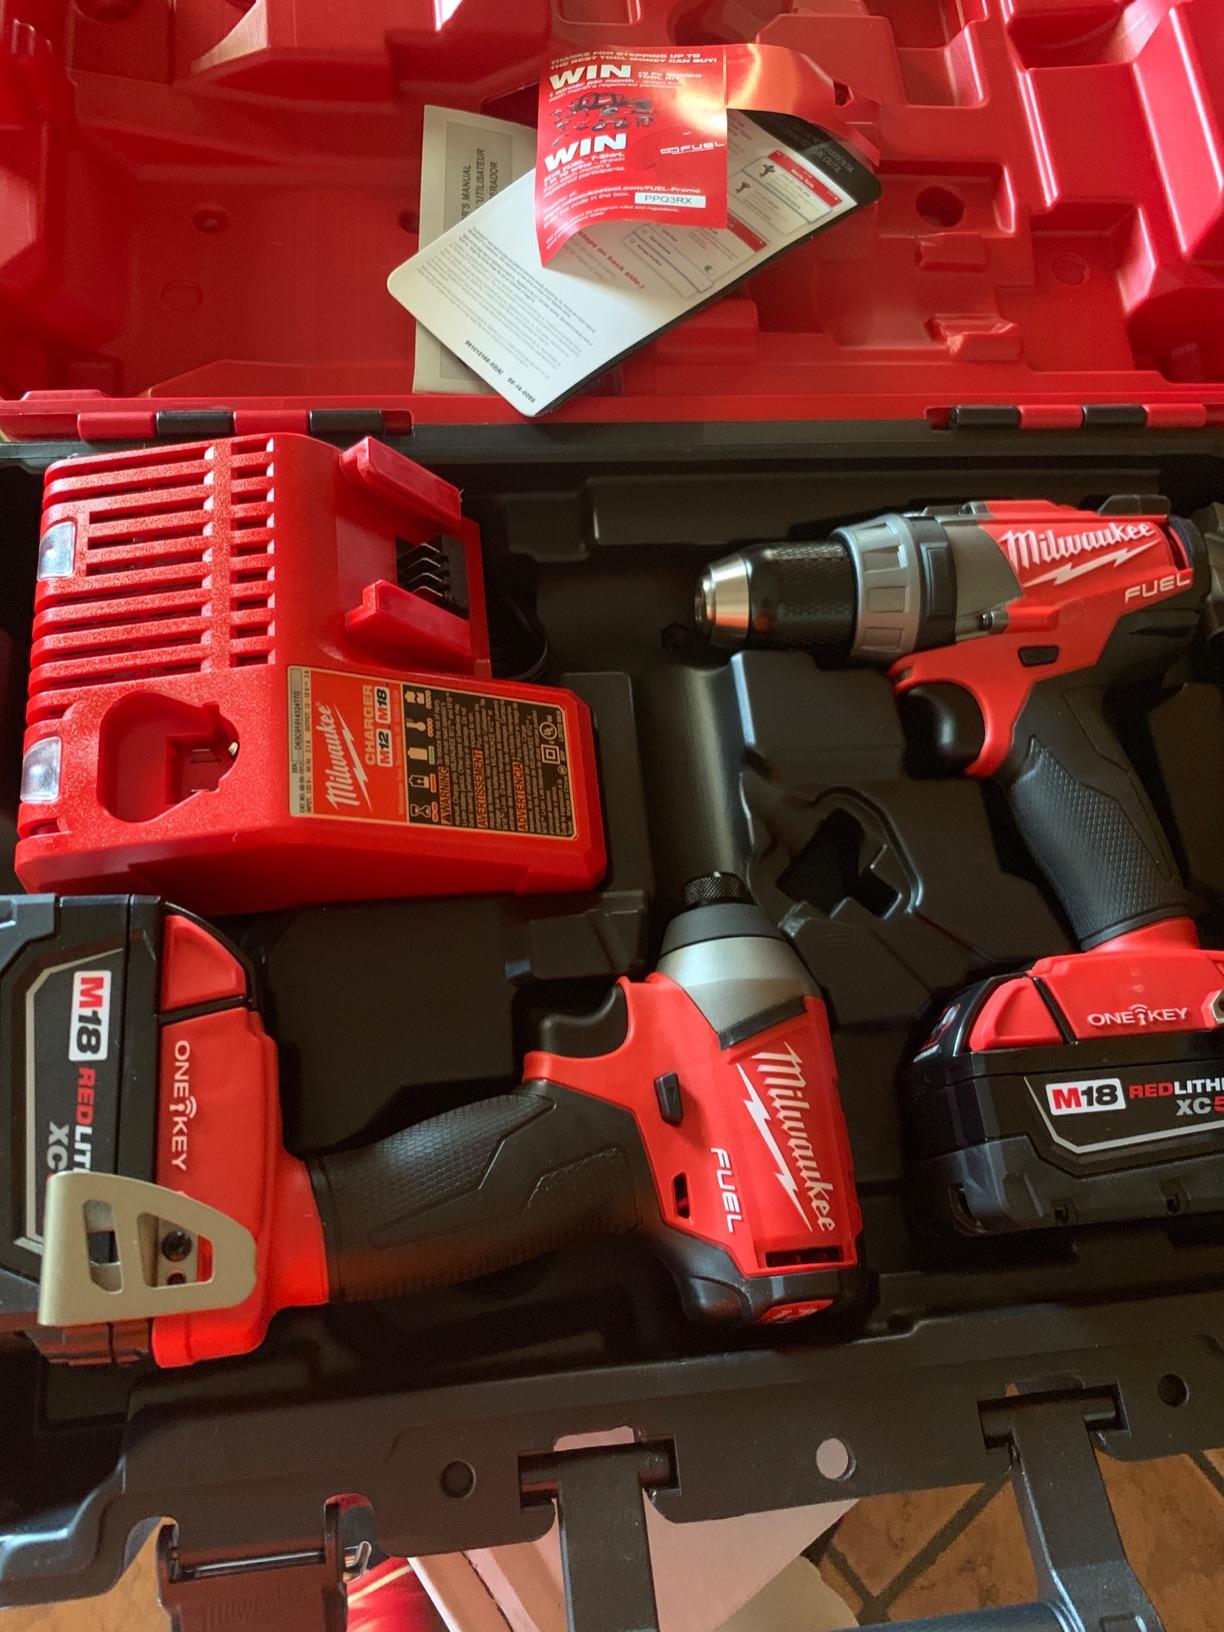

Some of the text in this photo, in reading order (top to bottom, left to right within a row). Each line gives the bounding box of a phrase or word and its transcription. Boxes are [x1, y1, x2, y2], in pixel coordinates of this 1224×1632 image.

[549, 64, 632, 90] WIN
[462, 164, 472, 200] MANUAL
[544, 132, 627, 172] WIN
[644, 194, 692, 204] PPQ3RX
[997, 522, 1155, 575] Milwaukee
[1124, 572, 1192, 604] FUEL
[362, 684, 376, 766] CHARGER
[376, 688, 391, 766] M12 M18
[316, 704, 360, 810] Milwaukee
[438, 767, 451, 814] WARNING
[473, 751, 488, 827] AVERTISSEMENT
[512, 762, 528, 830] ADVERTENCIA
[75, 972, 106, 1056] M18
[1087, 1007, 1188, 1026] ONE KEY
[73, 1066, 96, 1172] REDLIT
[172, 1040, 190, 1172] ONE KEY
[1050, 1082, 1120, 1111] M18
[46, 1120, 70, 1172] XC
[751, 1040, 836, 1232] Milwaukee
[710, 1147, 742, 1234] FUEL
